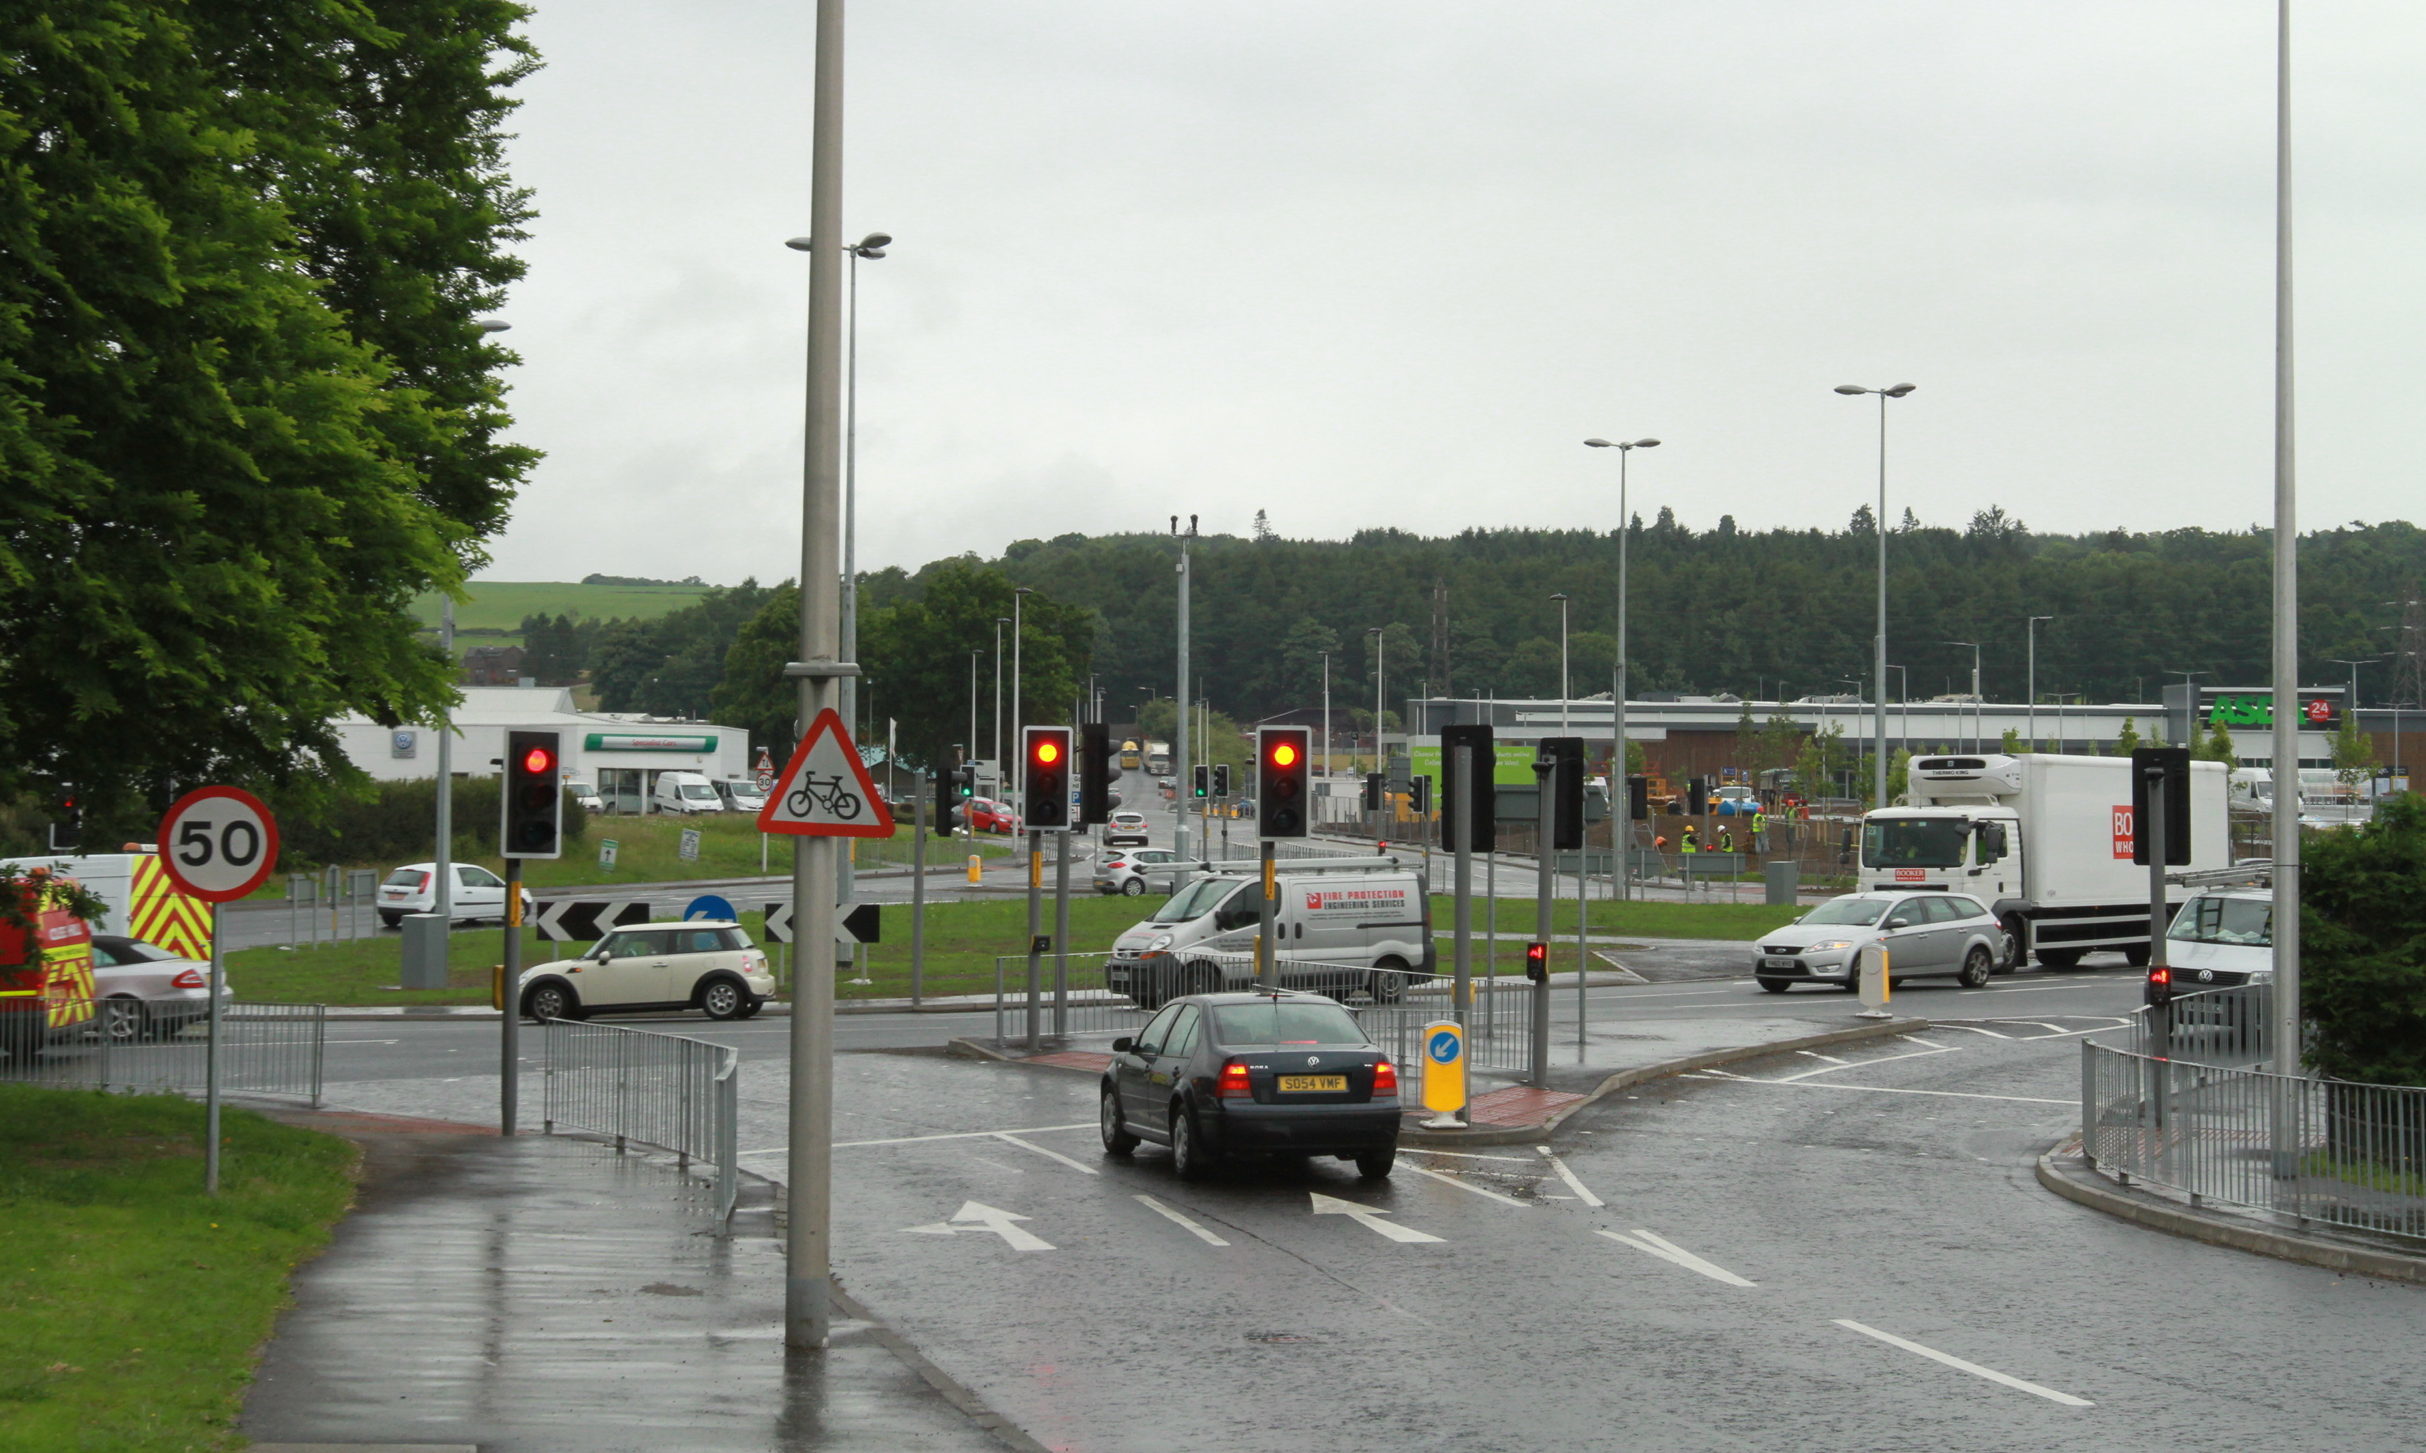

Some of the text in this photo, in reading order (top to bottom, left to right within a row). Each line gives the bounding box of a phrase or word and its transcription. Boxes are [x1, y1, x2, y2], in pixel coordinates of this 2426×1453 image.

[2311, 702, 2329, 714] 24
[759, 778, 771, 787] 30
[179, 820, 259, 867] 50
[1323, 890, 1405, 900] FIRE PROTECTION
[1324, 900, 1406, 910] ENGINEERING SERVICES
[1319, 1078, 1342, 1089] VMF
